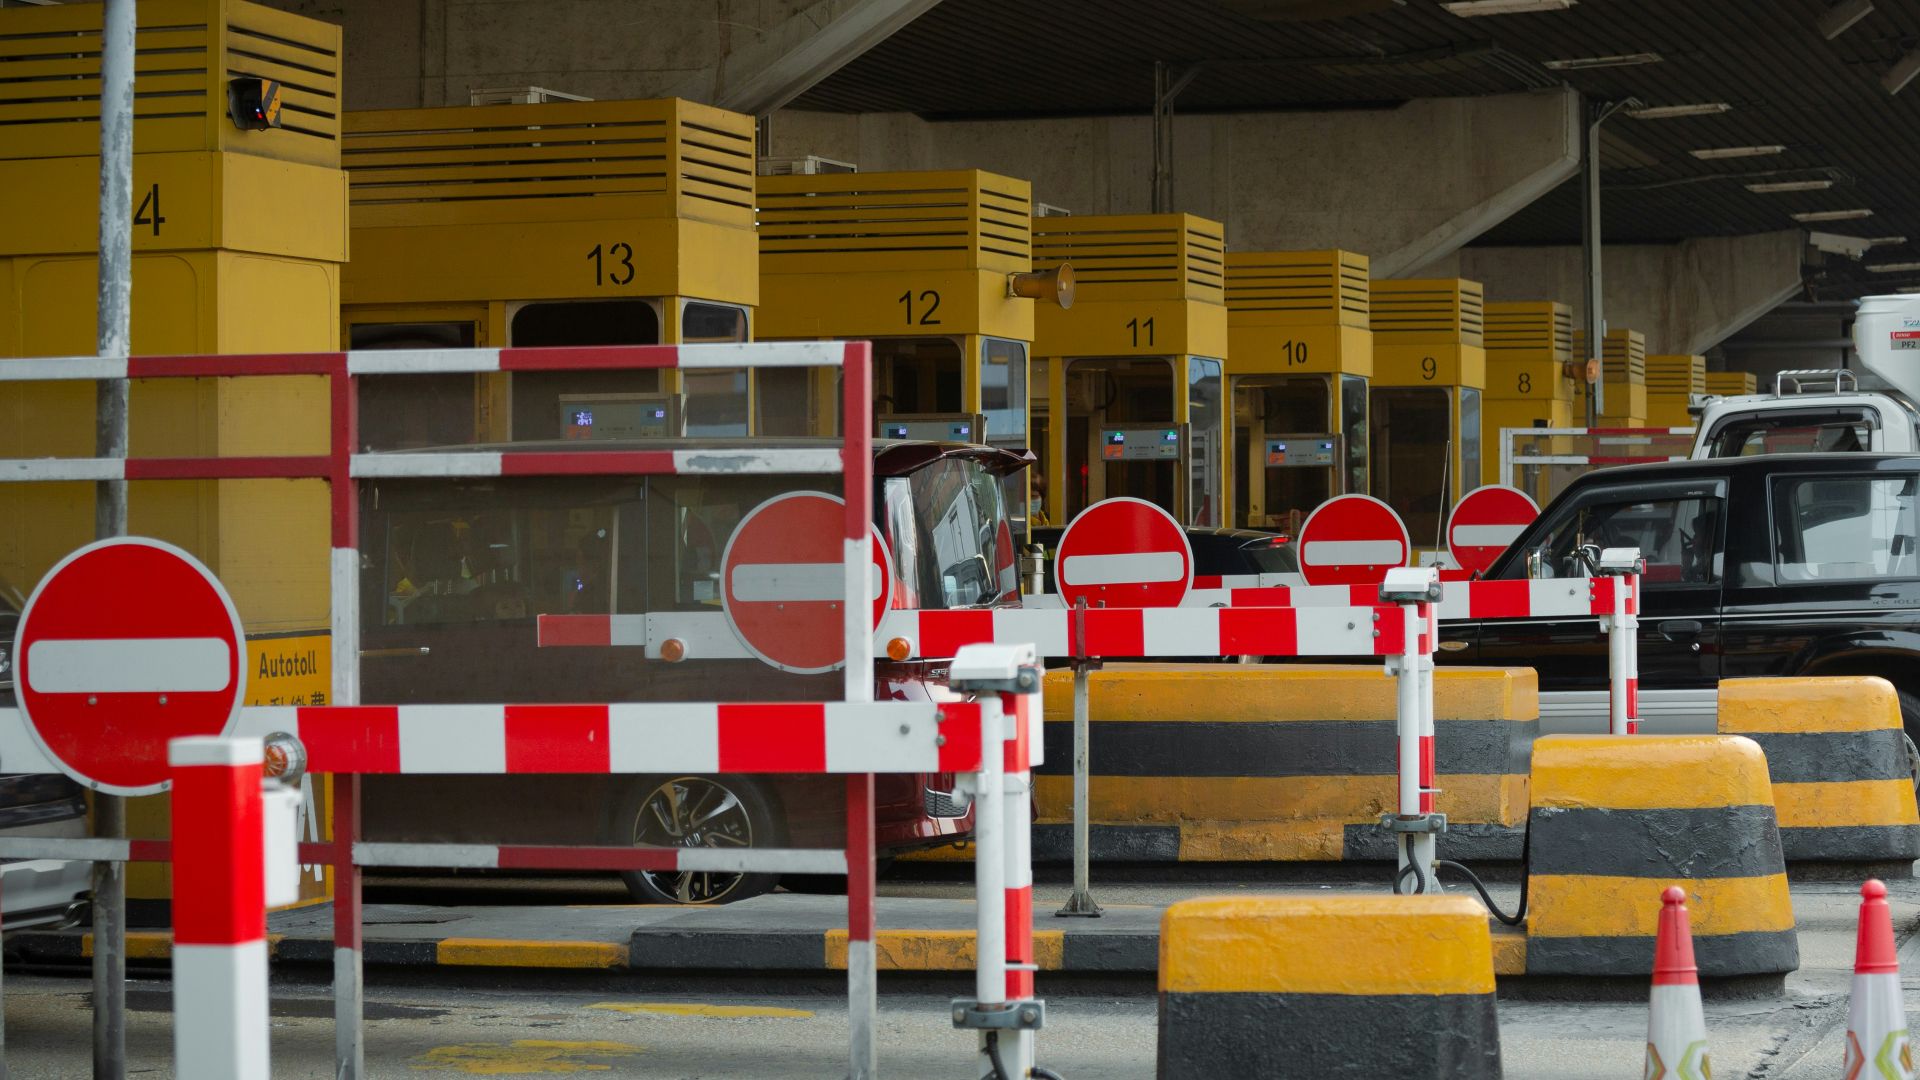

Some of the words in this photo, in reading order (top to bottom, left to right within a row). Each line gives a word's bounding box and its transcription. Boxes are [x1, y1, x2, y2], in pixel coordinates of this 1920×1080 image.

[587, 242, 635, 286] 13
[899, 290, 941, 325] 12
[1126, 317, 1154, 347] 11
[1282, 340, 1308, 366] 10
[1422, 356, 1436, 380] 9
[1518, 373, 1531, 393] 8
[259, 650, 317, 680] Autotoll
